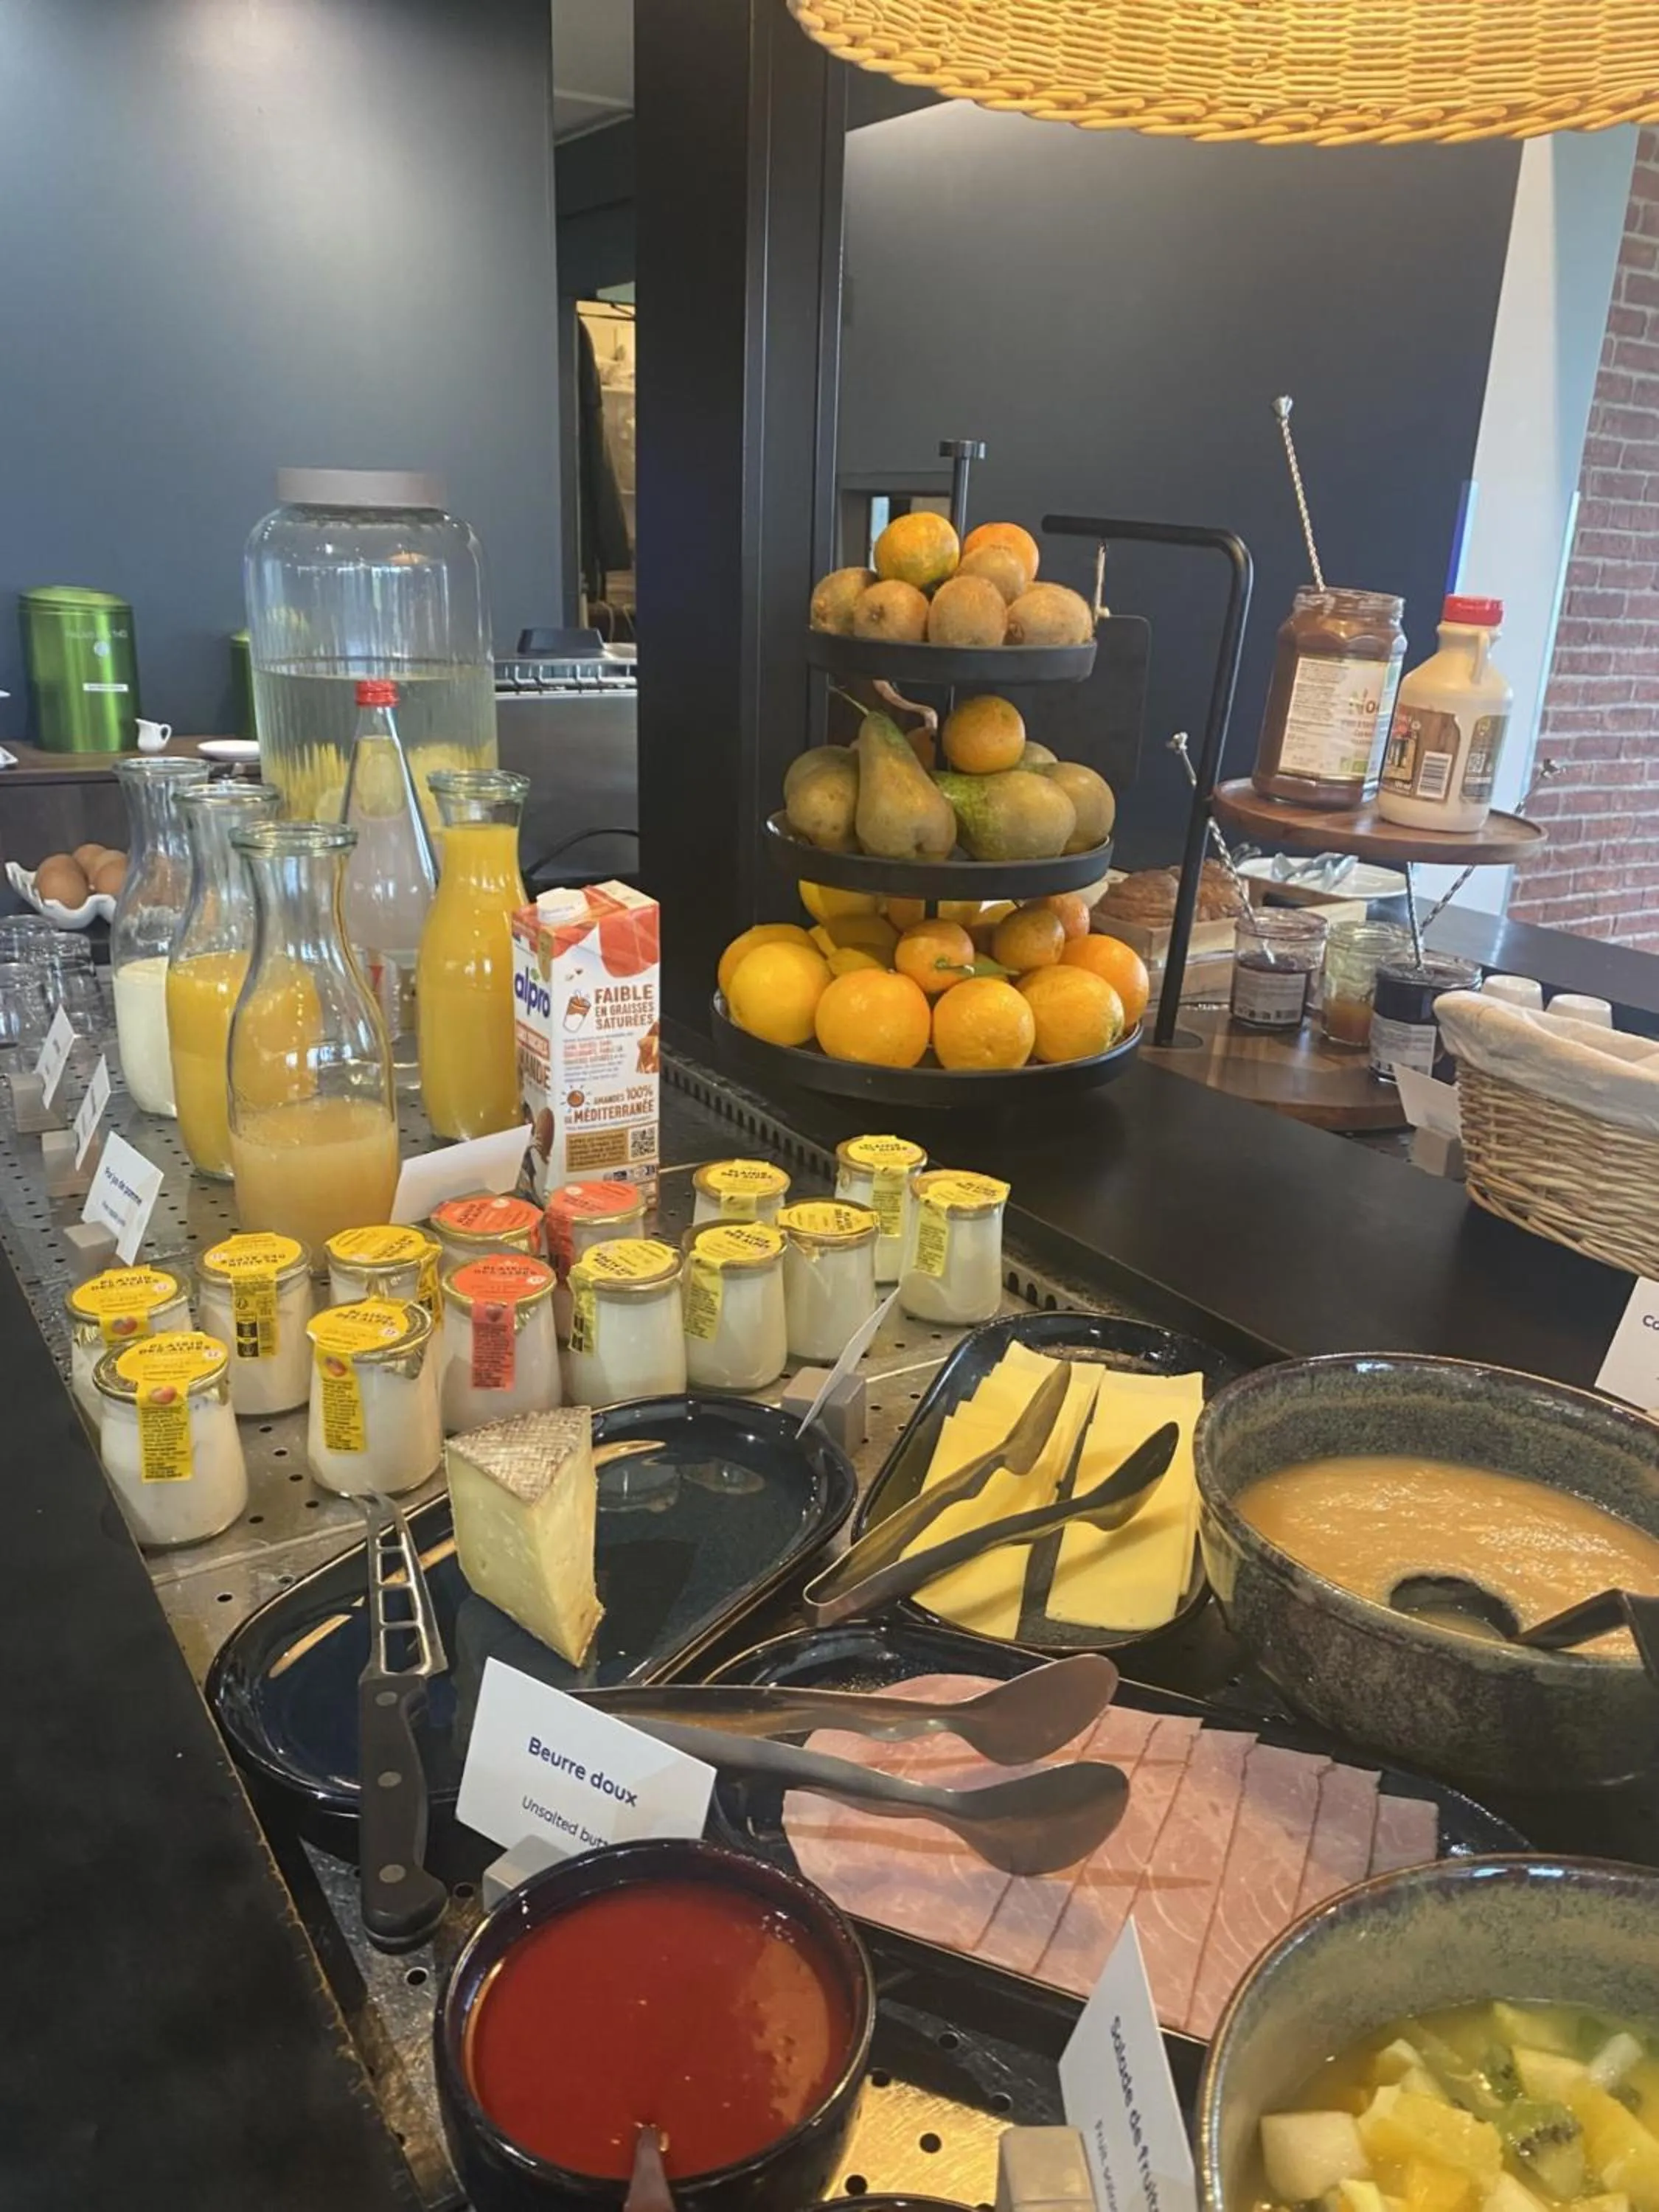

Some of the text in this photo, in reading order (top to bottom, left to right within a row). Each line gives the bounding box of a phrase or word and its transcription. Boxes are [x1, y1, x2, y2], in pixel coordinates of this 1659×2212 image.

[515, 967, 551, 1018] alpro
[594, 984, 654, 1004] FAIBLE
[595, 1001, 655, 1018] EN GRAISSES
[595, 1014, 654, 1031] SATURÉES
[574, 1099, 655, 1124] MÉDITERRANÉE
[528, 1736, 639, 1808] Beurre doux
[521, 1796, 579, 1836] Unsalted
[1110, 2015, 1133, 2108] Salade
[1130, 2110, 1141, 2147] de
